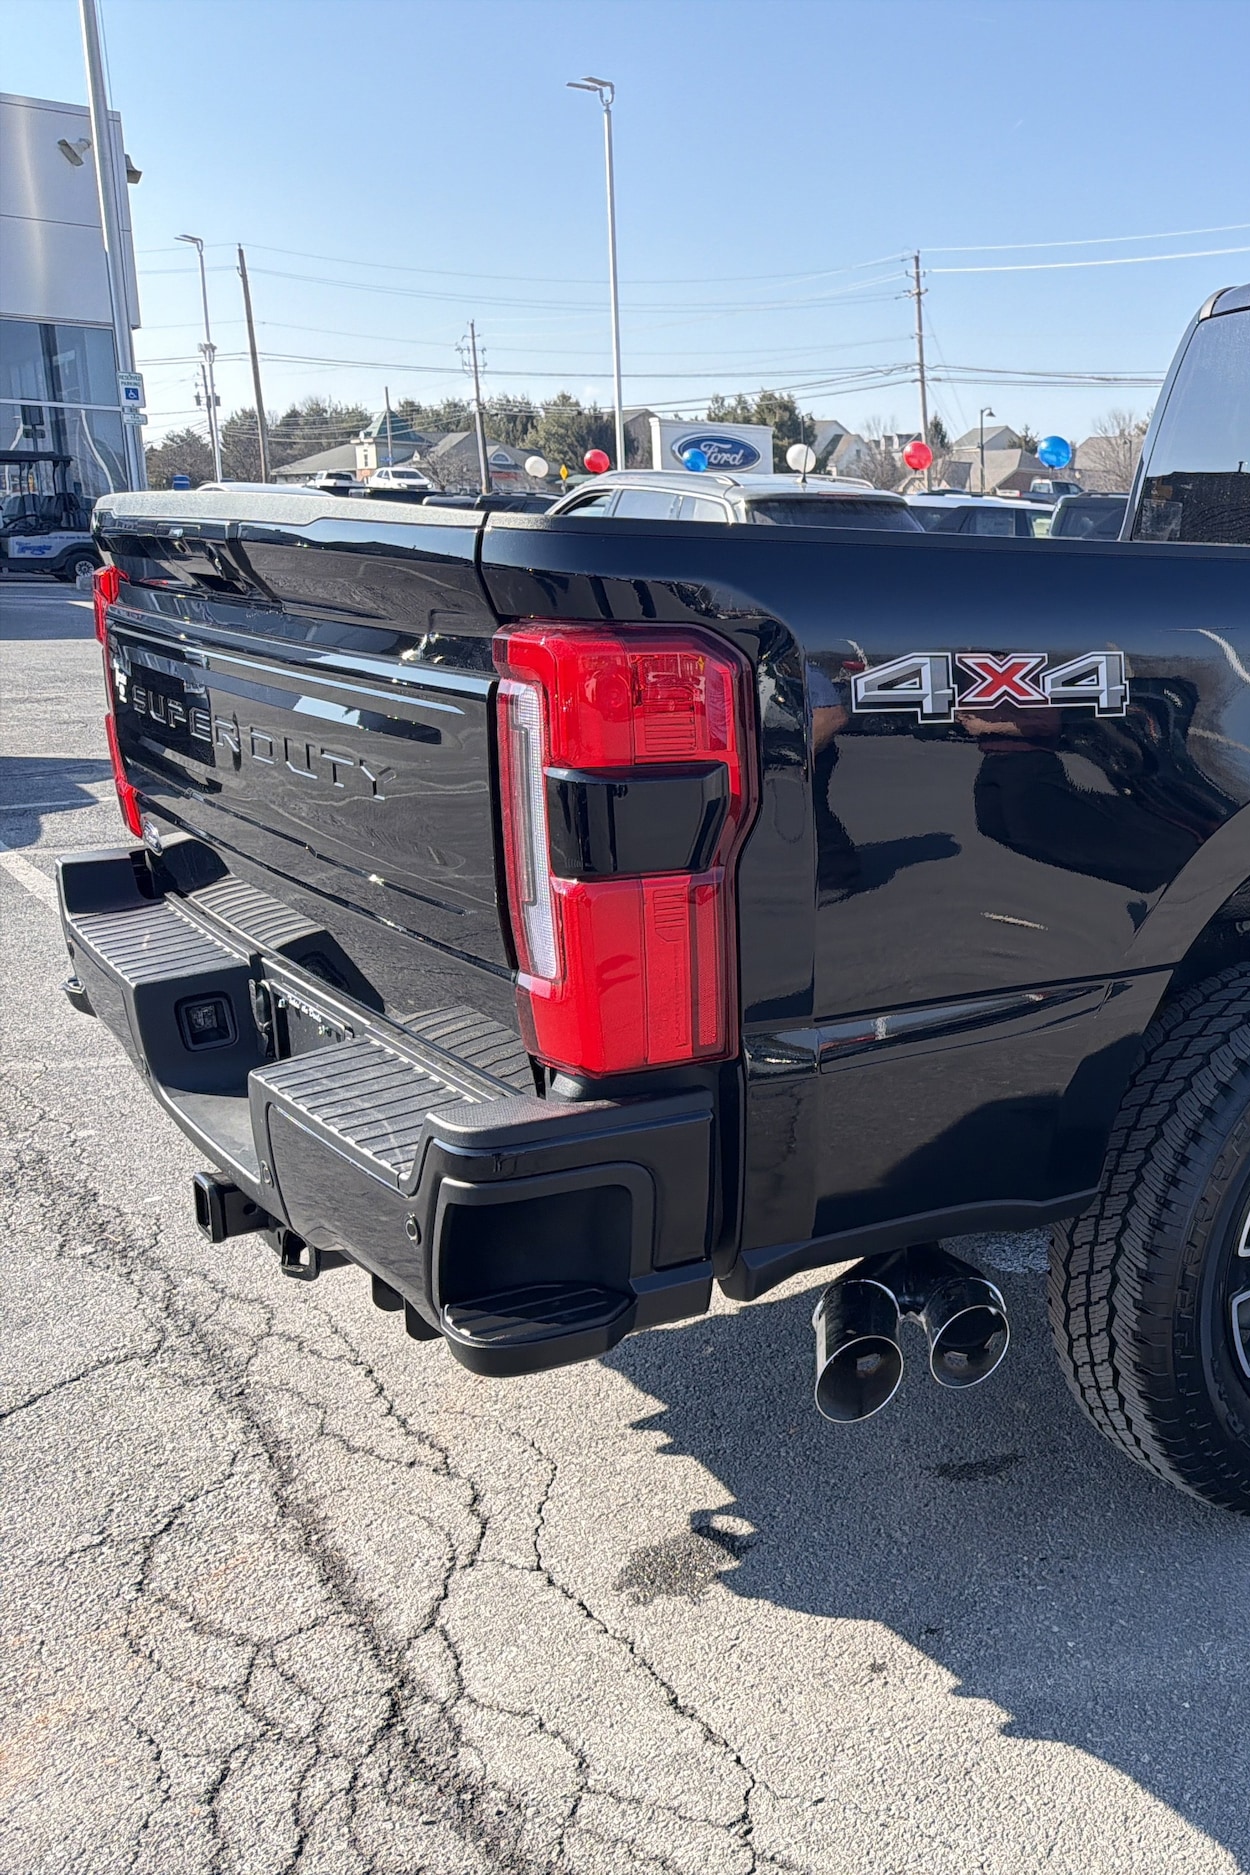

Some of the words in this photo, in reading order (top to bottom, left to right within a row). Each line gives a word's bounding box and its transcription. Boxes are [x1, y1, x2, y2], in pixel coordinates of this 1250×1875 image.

[700, 441, 744, 466] Ford
[132, 683, 240, 752] SUPER
[250, 726, 397, 801] DUTY
